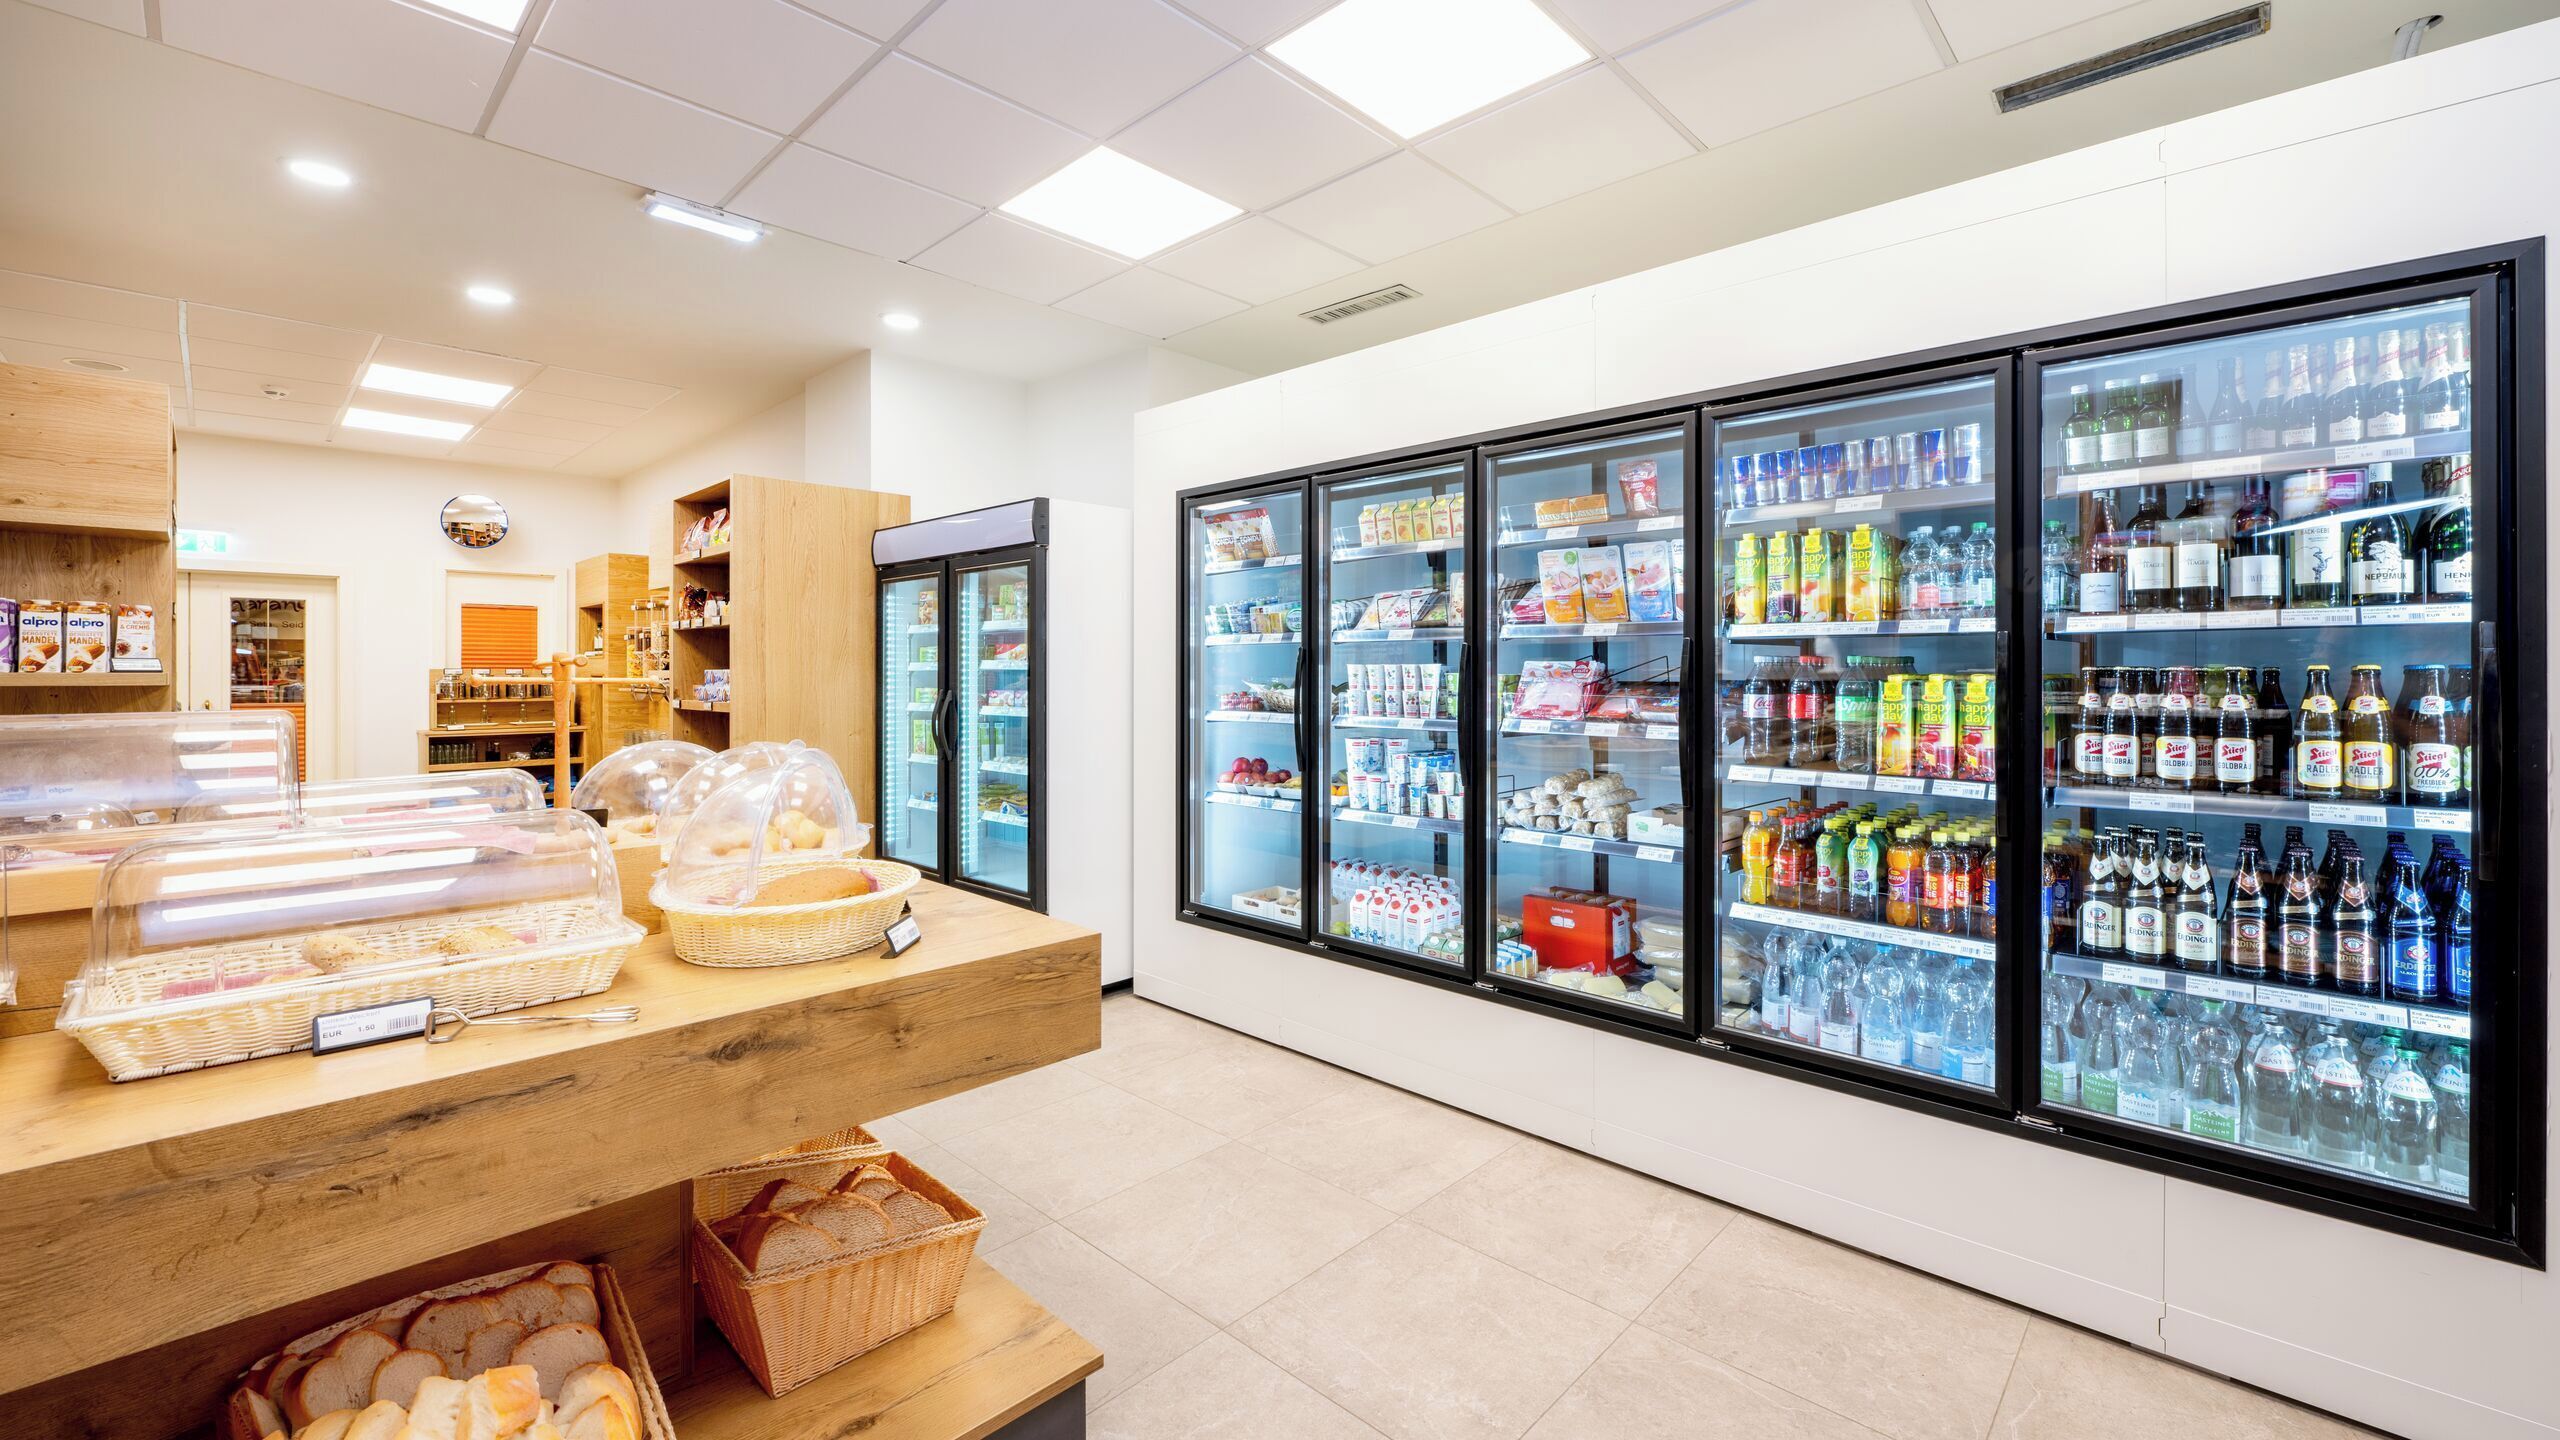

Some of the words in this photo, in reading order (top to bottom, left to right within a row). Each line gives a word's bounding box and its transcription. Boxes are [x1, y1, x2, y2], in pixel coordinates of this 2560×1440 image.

[2364, 571, 2408, 582] NEPOMUK
[2444, 572, 2472, 580] HENK
[22, 615, 59, 628] alpro
[69, 617, 104, 629] alpro
[22, 635, 58, 644] MANDEL
[69, 637, 104, 645] MANDEL
[1917, 702, 1952, 715] happy
[1959, 702, 1995, 716] happy
[1923, 711, 1945, 725] day
[1965, 713, 1988, 726] day
[2108, 740, 2131, 752] Stiegl
[2165, 742, 2190, 754] Stiegl
[2221, 744, 2247, 756] Stiegl
[2309, 747, 2337, 761] Stiegl
[2351, 747, 2381, 762] Stiegl
[2416, 751, 2447, 765] Stiegl
[2306, 764, 2340, 774] RADLER
[2349, 765, 2384, 776] RADLER
[2084, 920, 2116, 933] ERDINGER
[2129, 926, 2164, 939] ERDINGER
[2177, 931, 2214, 944] ERDINGER
[2412, 1018, 2427, 1026] EUR
[322, 1030, 342, 1039] EUR
[358, 1024, 376, 1033] 1.50
[2192, 1113, 2231, 1127] GASTEINER
